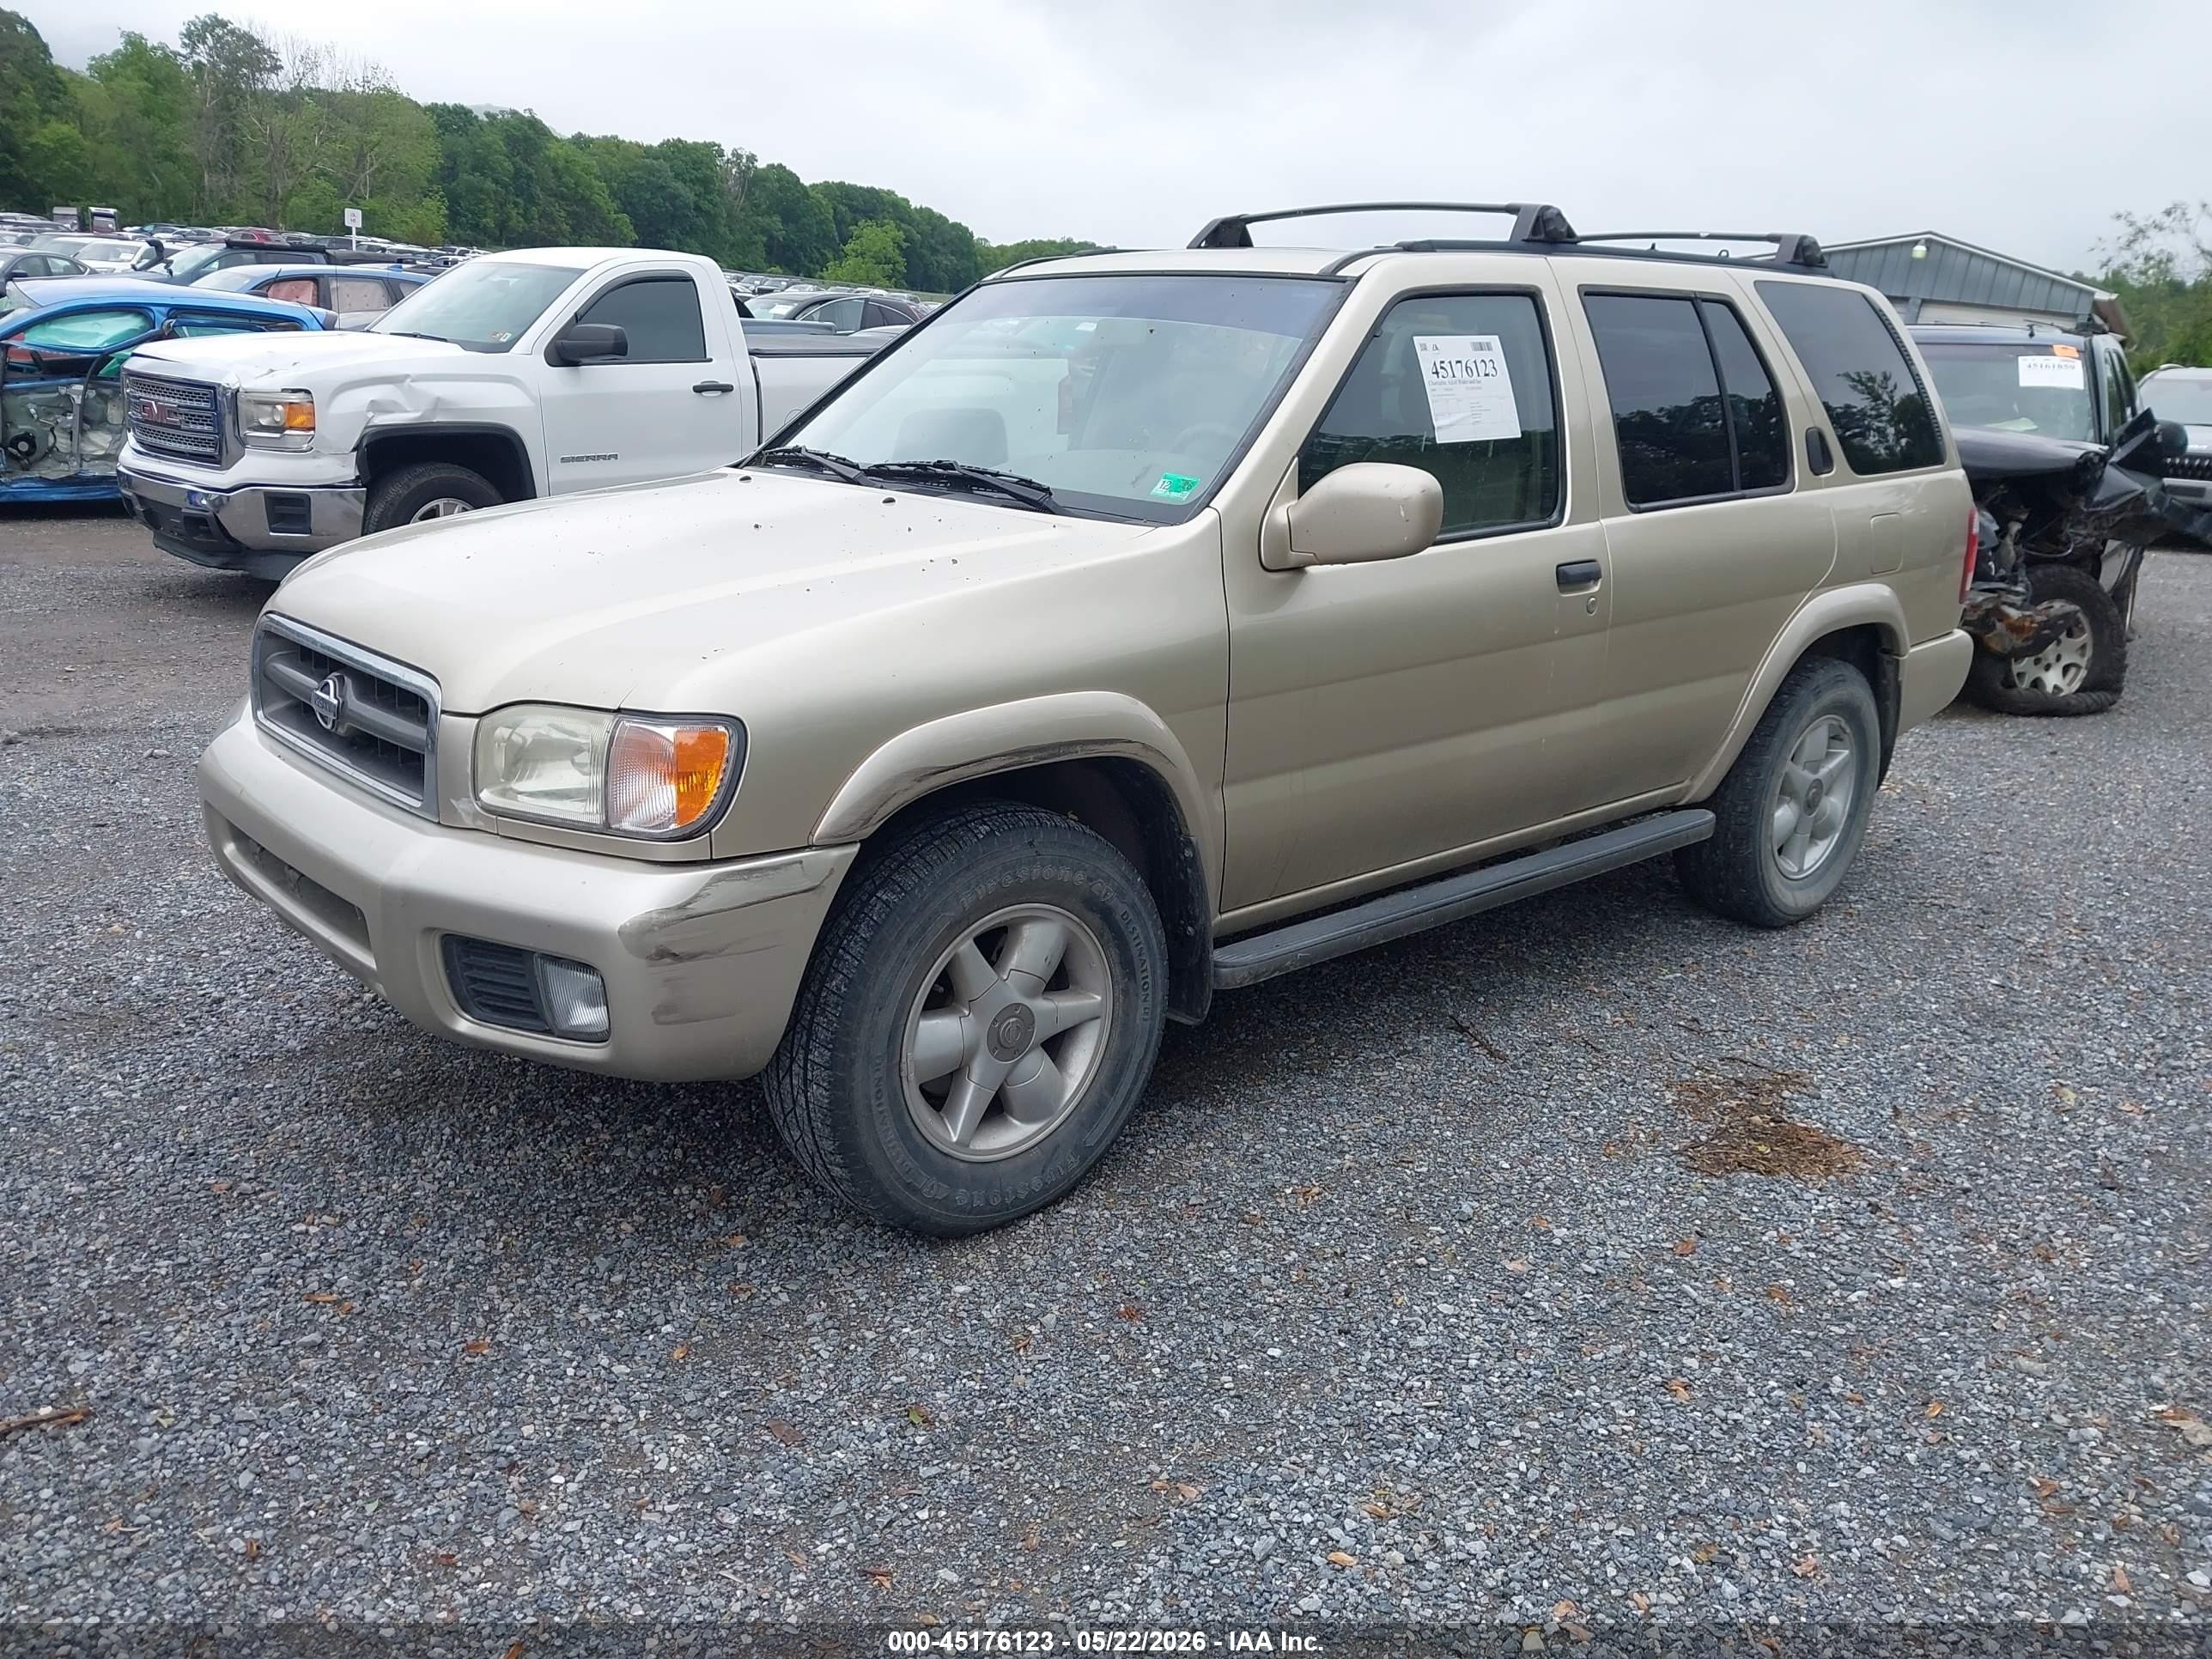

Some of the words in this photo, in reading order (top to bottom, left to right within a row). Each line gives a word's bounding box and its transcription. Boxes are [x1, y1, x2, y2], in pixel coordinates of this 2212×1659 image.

[1431, 358, 1498, 379] 45176123
[140, 398, 182, 427] GMC
[559, 453, 619, 464] SIERRA
[1159, 480, 1172, 490] 12
[959, 863, 1088, 911] Firestone
[1119, 909, 1152, 1004] DESTINATION
[954, 1152, 1081, 1208] Firestone
